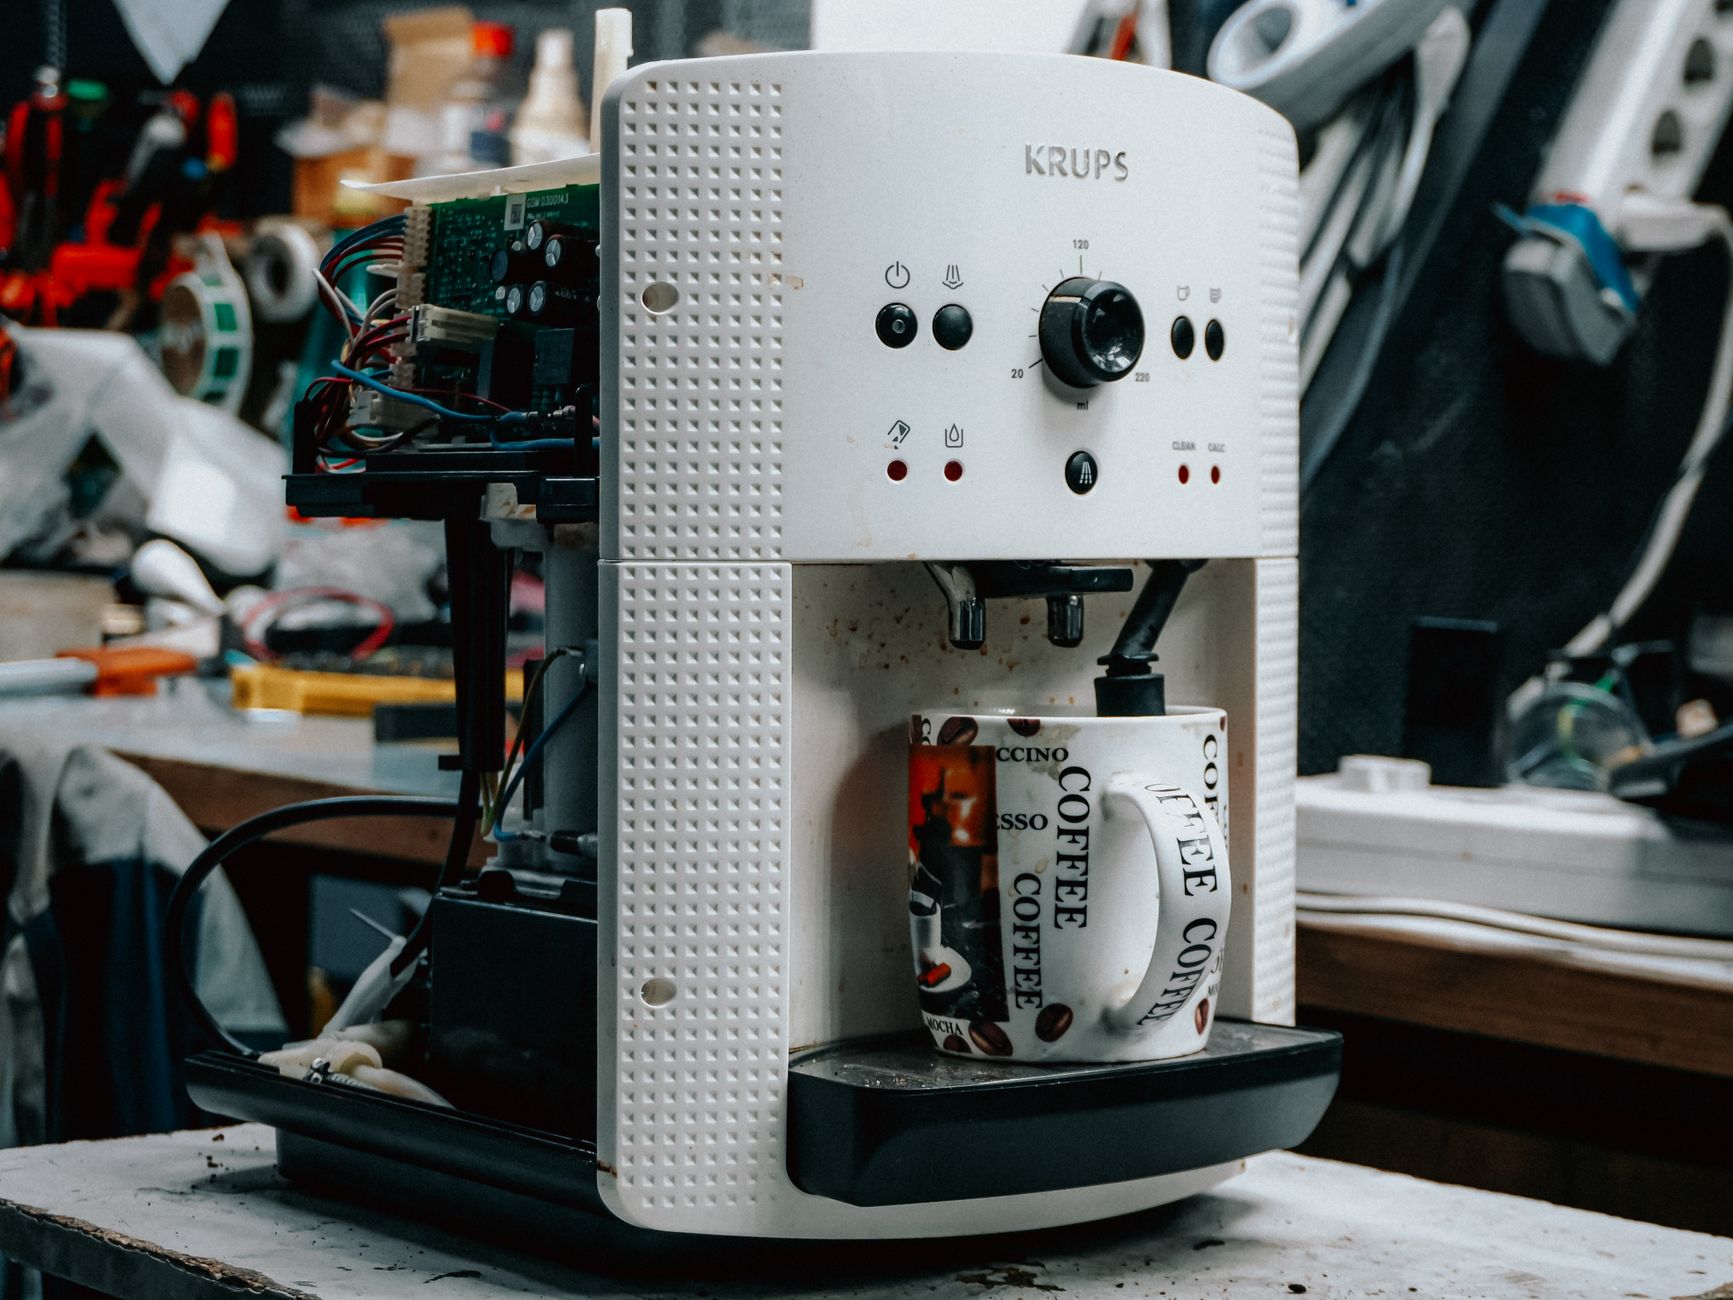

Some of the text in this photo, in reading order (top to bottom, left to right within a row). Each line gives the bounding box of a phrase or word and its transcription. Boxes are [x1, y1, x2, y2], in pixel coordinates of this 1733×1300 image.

[1025, 144, 1129, 181] KRUPS
[1072, 239, 1090, 250] 120
[1011, 368, 1024, 379] 20
[1134, 372, 1150, 383] 220
[1076, 400, 1089, 411] ml
[1171, 440, 1197, 451] CLEAN
[1207, 442, 1225, 453] CALC
[1053, 766, 1091, 929] COFFEE
[1013, 872, 1042, 1010] COFFEE
